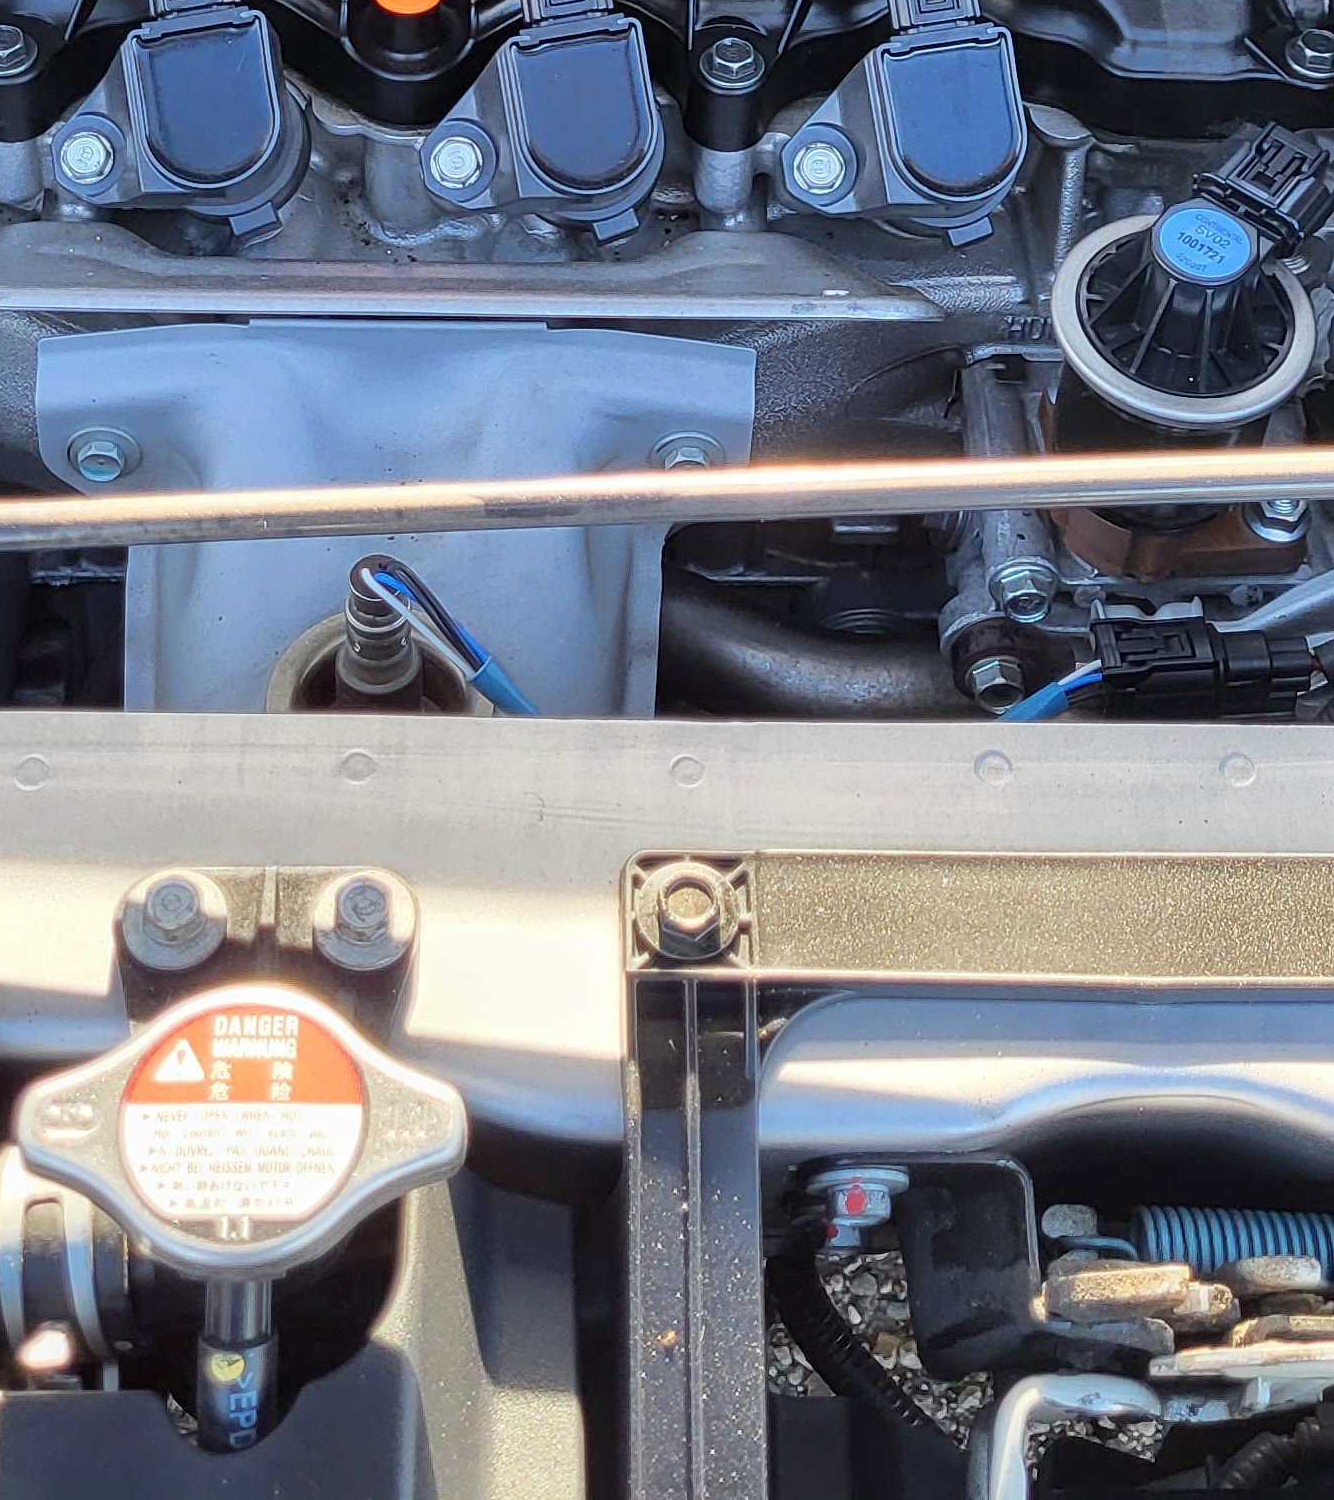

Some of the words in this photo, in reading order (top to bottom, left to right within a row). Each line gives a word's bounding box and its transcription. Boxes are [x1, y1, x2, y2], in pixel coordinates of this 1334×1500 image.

[1176, 230, 1226, 265] 1001721
[213, 1015, 299, 1037] DANGER
[257, 1161, 291, 1173] MOTOR
[217, 1215, 251, 1240] 1.1
